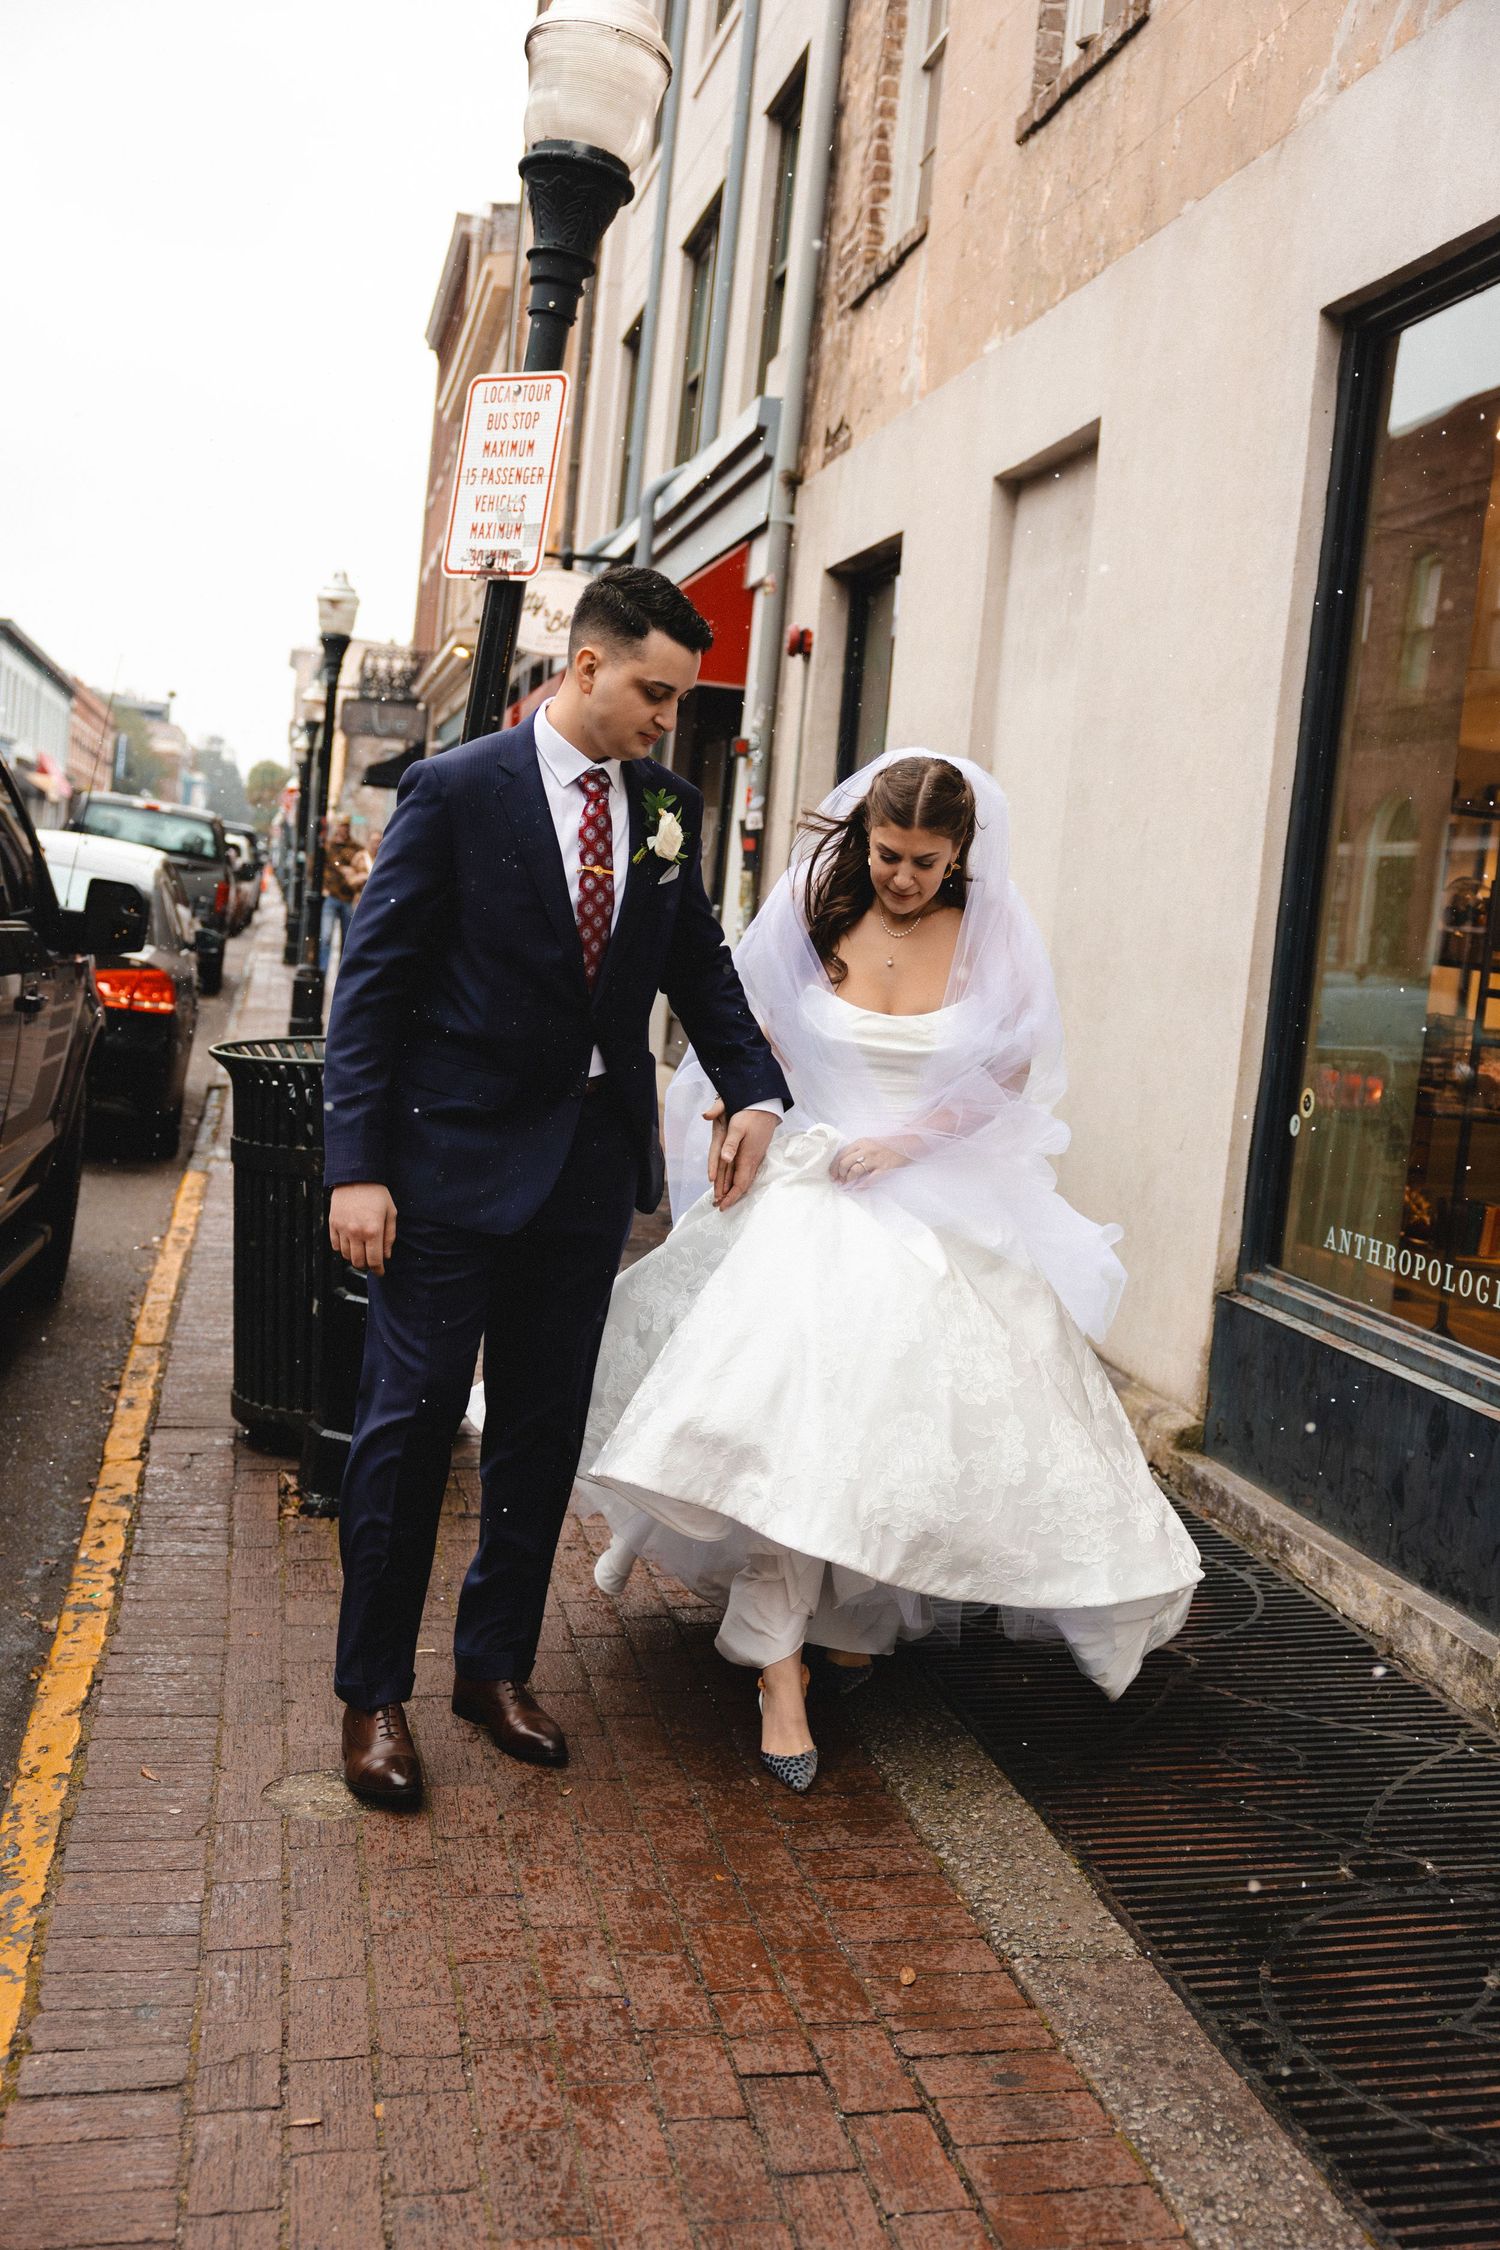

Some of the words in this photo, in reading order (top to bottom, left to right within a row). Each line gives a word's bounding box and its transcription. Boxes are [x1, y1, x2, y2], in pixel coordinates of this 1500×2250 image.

[522, 383, 552, 402] TOUR
[487, 412, 509, 430] BUS
[512, 411, 540, 430] STOP
[482, 439, 535, 458] MAXIMUM
[465, 468, 478, 486] 15
[480, 466, 545, 485] PASSENGER
[469, 522, 522, 540] MAXIMUM
[469, 548, 484, 567] 30
